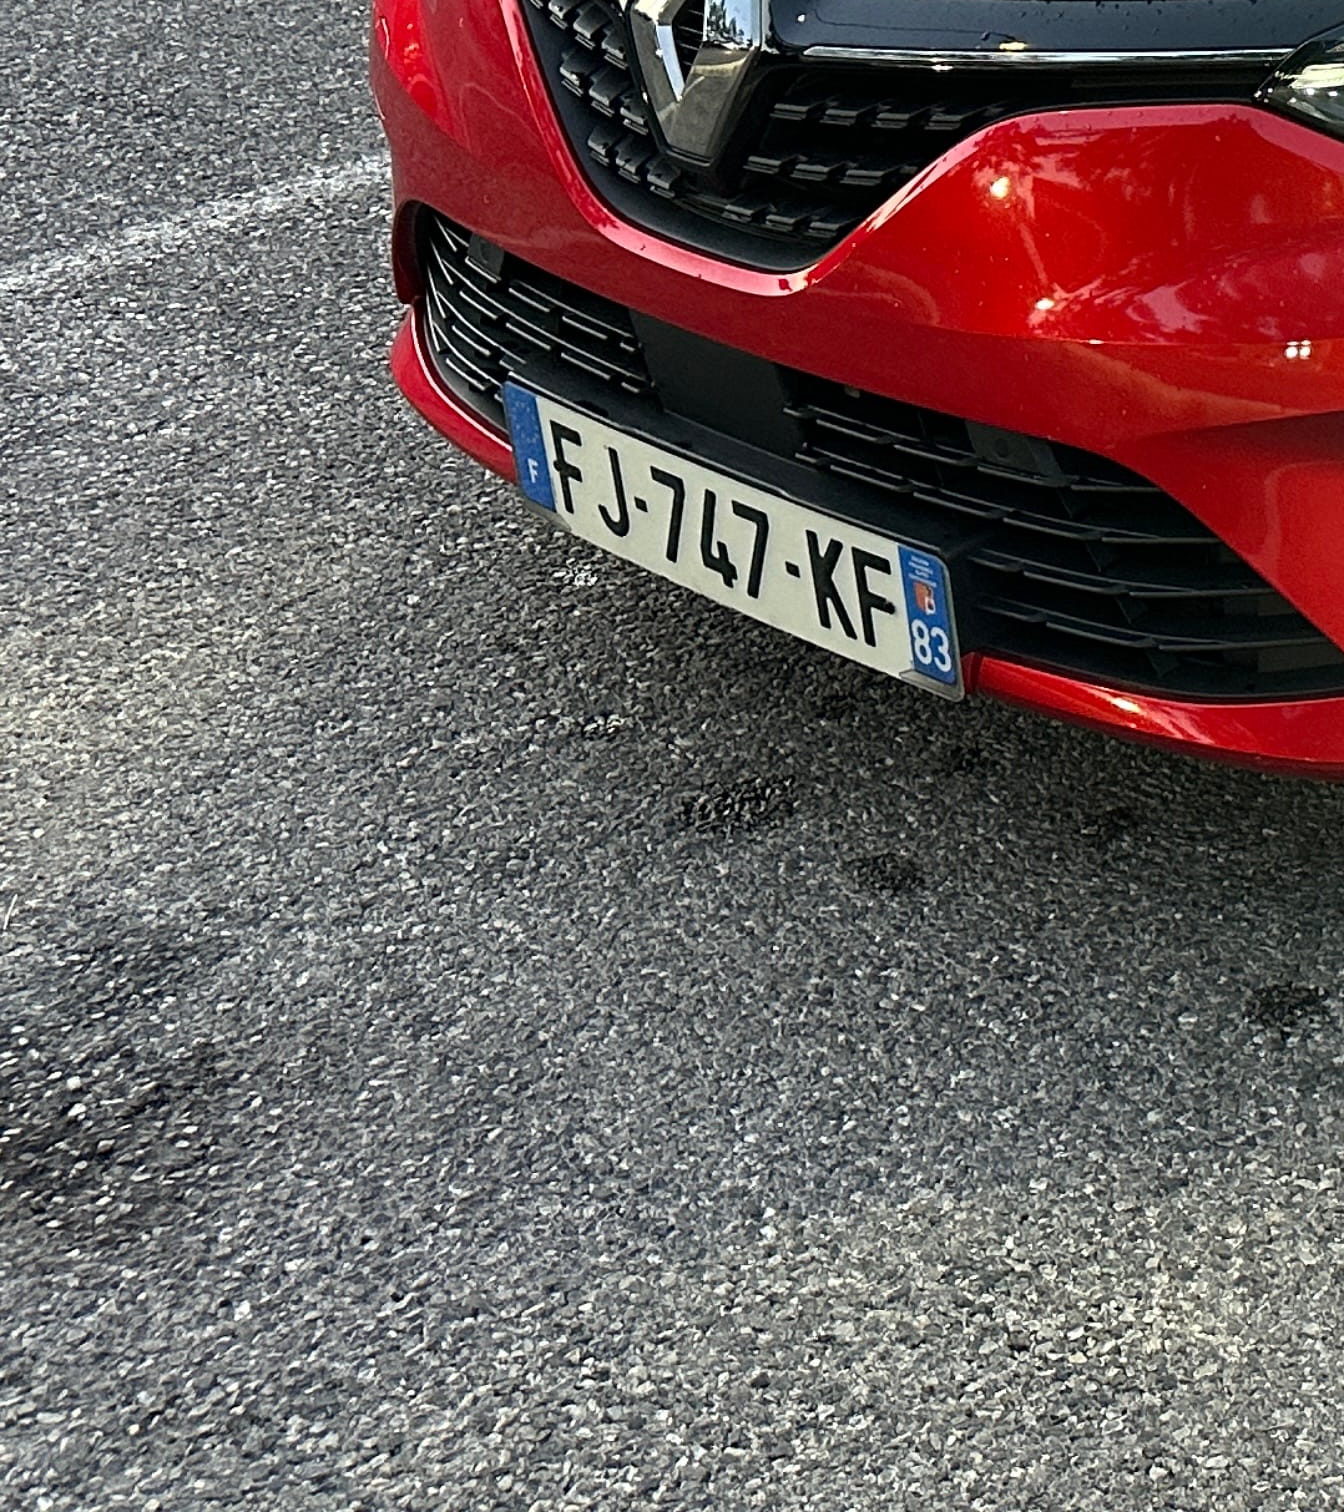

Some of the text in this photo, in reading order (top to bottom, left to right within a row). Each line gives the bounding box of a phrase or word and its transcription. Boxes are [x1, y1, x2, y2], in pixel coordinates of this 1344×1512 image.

[527, 458, 540, 485] F
[549, 418, 896, 648] FJ-747-KF
[911, 619, 953, 673] 83
